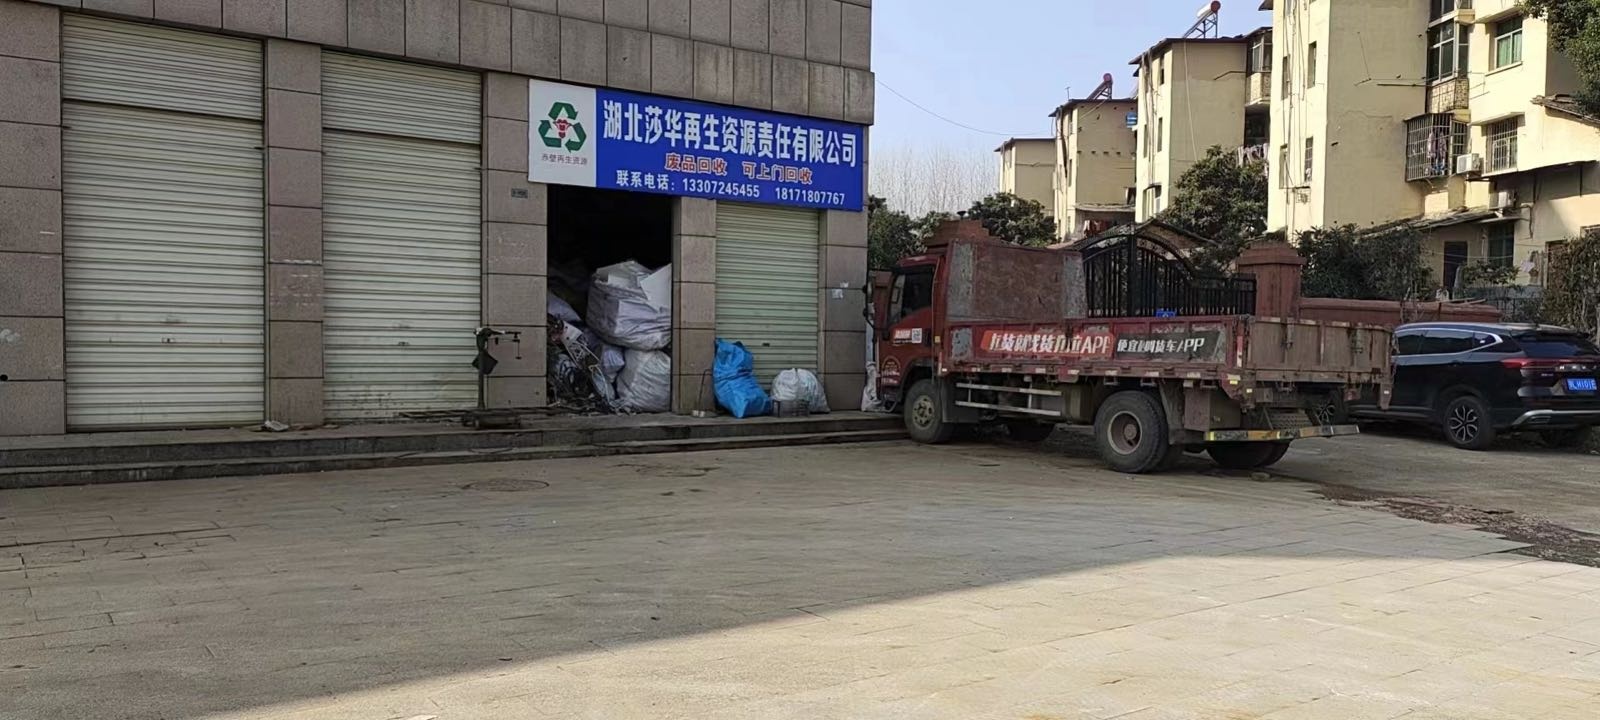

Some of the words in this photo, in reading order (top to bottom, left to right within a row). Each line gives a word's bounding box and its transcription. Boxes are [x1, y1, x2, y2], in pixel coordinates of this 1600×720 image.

[603, 100, 856, 167] 湖北莎华再生资源责任有限公司
[664, 153, 728, 176] 废品回收
[742, 161, 813, 185] 可上门回收
[682, 178, 760, 198] 13307245455
[775, 187, 845, 205] 18171807767
